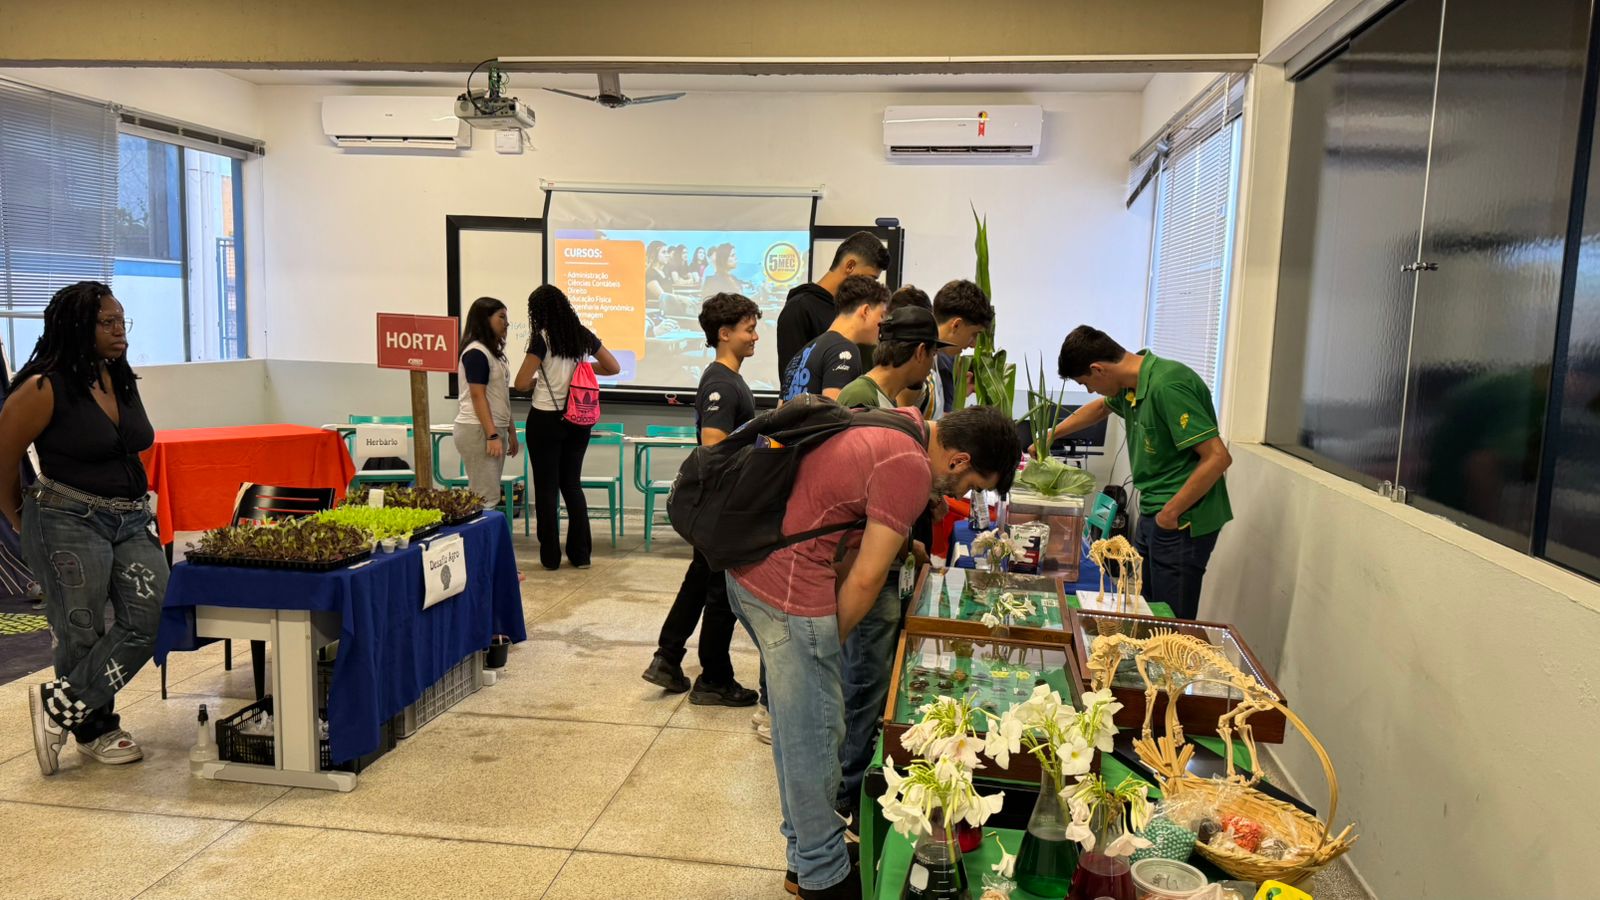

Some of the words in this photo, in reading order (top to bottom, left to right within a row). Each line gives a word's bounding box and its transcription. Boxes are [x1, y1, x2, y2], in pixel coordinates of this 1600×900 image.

[564, 248, 602, 258] CURSOS:
[769, 255, 777, 271] 5
[779, 259, 795, 268] MEC
[567, 272, 609, 280] Administração
[567, 279, 591, 287] Ciências
[600, 304, 635, 312] Agronômica
[386, 331, 448, 352] HORTA
[366, 438, 398, 446] Herbário
[429, 554, 448, 571] Desafio
[448, 551, 460, 562] Agro
